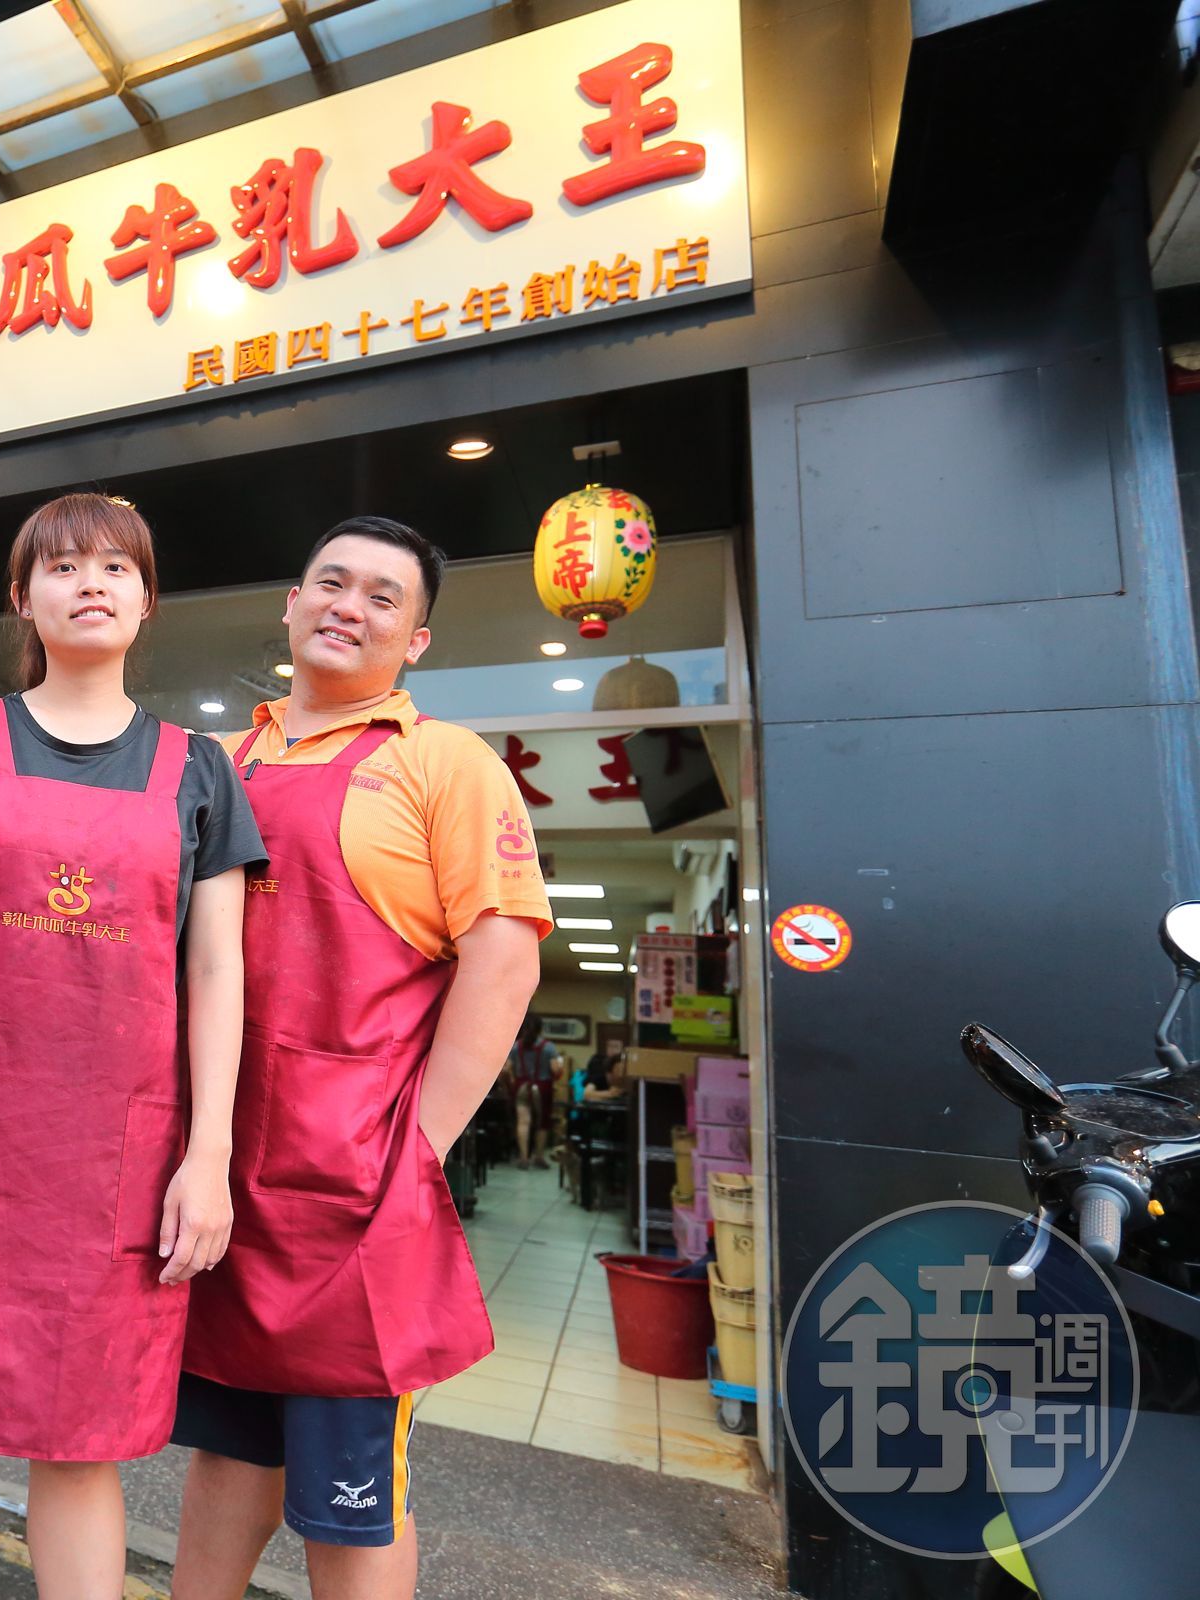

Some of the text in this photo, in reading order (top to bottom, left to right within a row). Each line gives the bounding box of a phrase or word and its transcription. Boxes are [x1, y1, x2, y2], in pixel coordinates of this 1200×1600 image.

[183, 236, 711, 394] 民國四十七年創始店
[553, 511, 594, 599] 上帝
[247, 879, 280, 893] 大王
[1, 911, 131, 943] 彰化木瓜牛乳大王
